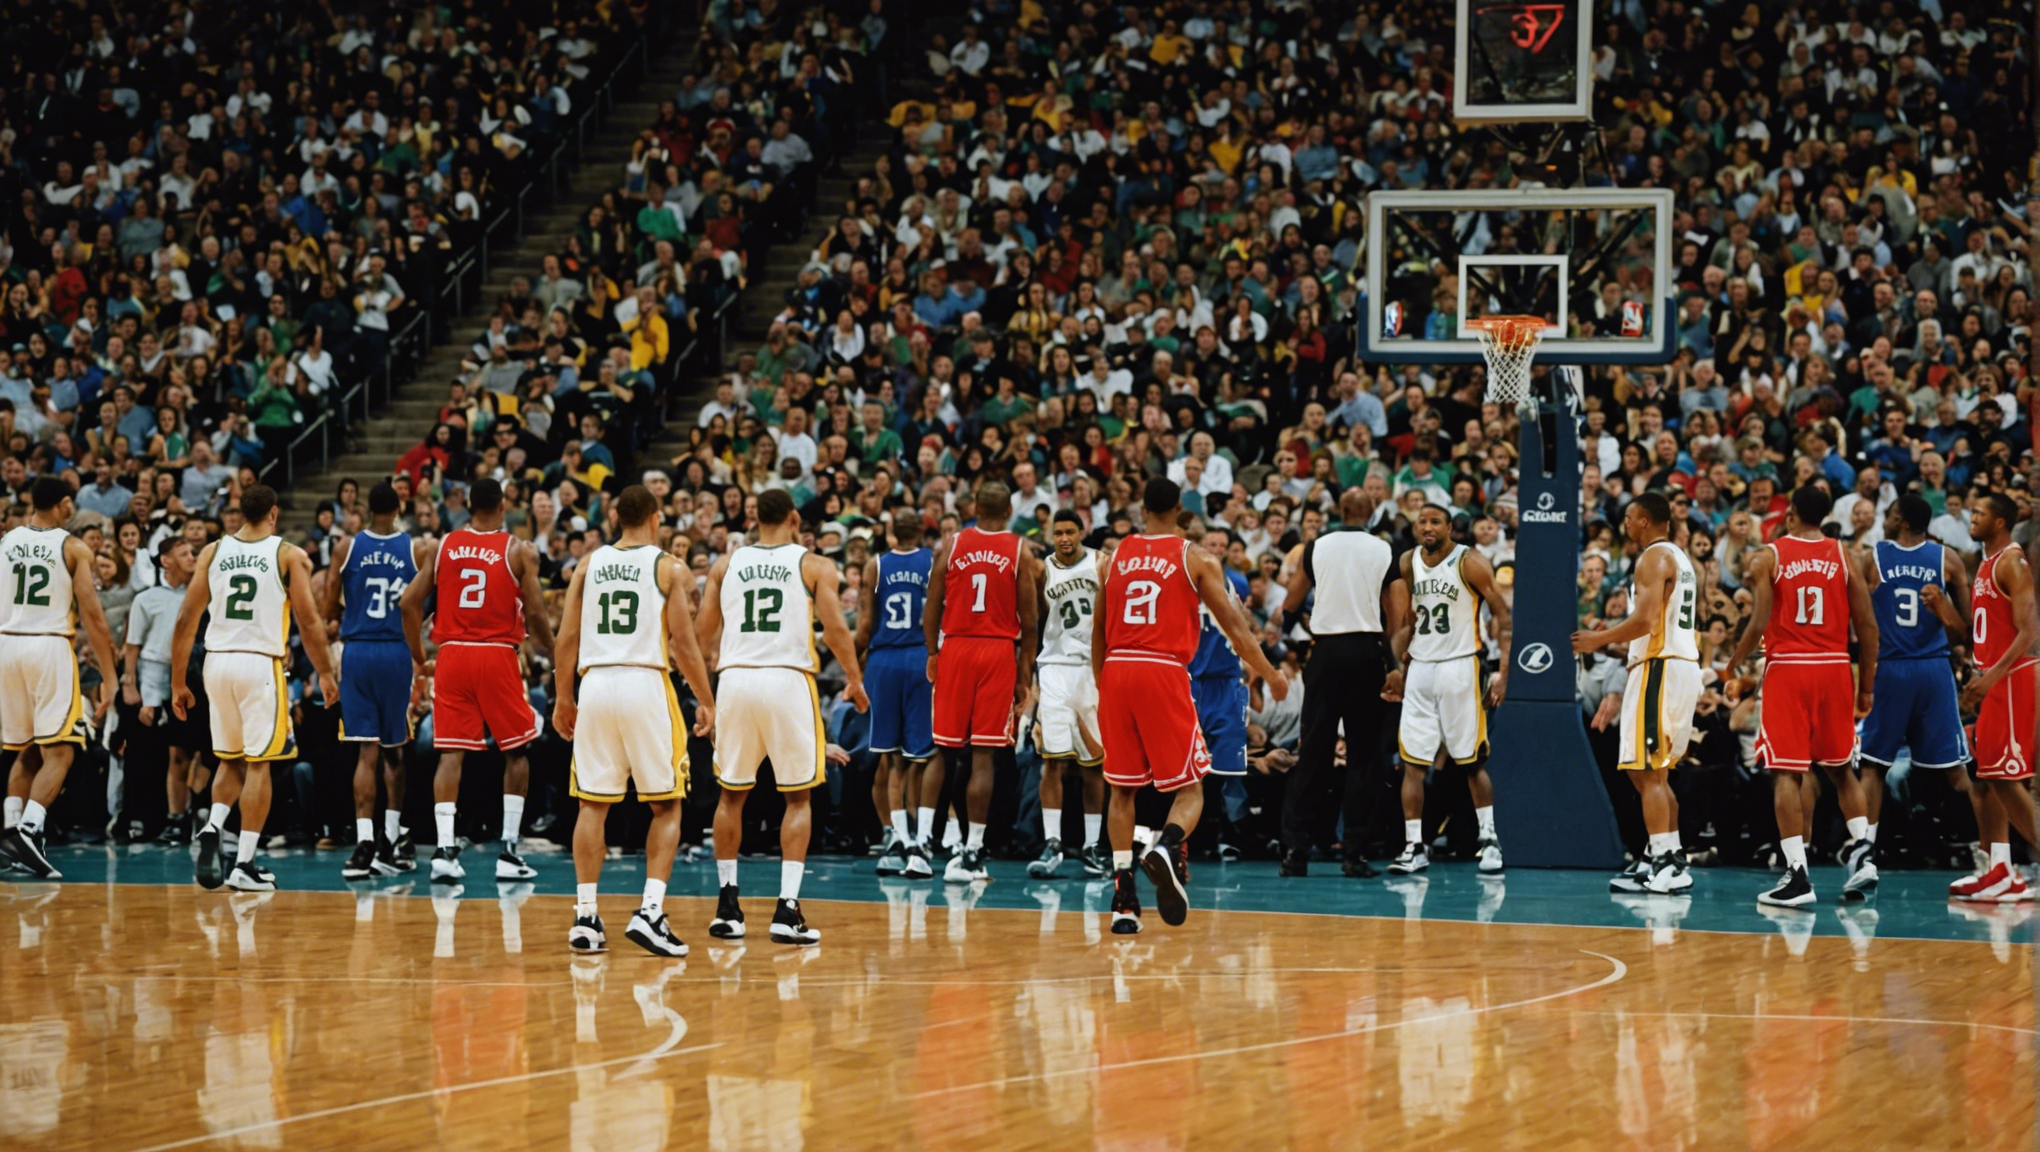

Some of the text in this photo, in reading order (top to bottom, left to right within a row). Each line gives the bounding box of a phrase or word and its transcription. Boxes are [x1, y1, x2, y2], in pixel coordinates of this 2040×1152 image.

[12, 562, 50, 606] 12
[225, 574, 257, 620] 2
[459, 569, 487, 608] 2
[1123, 580, 1162, 625] 21
[597, 590, 640, 634] 13
[740, 588, 783, 633] 12
[1894, 588, 1918, 627] 3
